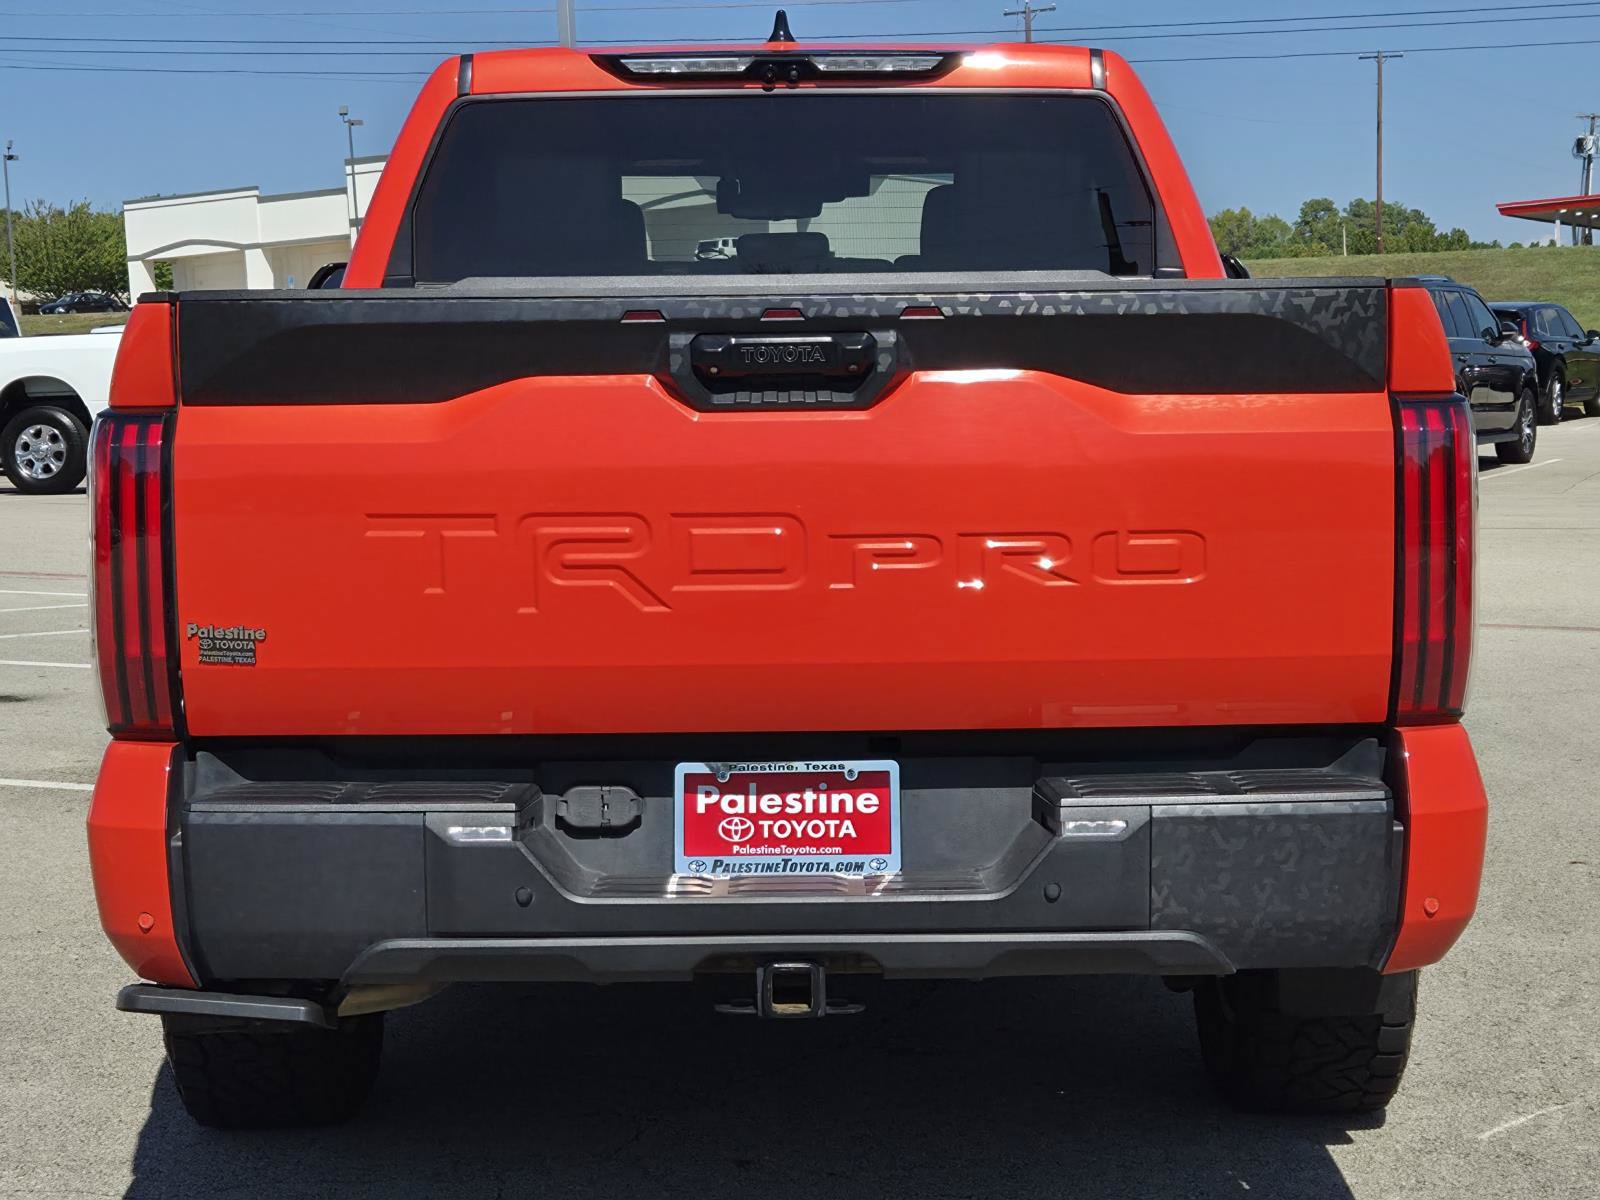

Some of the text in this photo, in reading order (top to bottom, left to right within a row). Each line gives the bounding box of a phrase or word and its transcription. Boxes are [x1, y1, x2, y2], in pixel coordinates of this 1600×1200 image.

[741, 346, 826, 363] TOYOTA
[364, 511, 1207, 613] TRD PRO
[187, 623, 266, 641] Palestine
[215, 640, 256, 650] TOYOTA
[235, 656, 256, 664] TEXAS
[728, 762, 846, 772] Palestine, Texas
[696, 783, 880, 814] Palestine
[758, 819, 857, 839] TOYOTA
[732, 845, 842, 856] PalestineToyota.com
